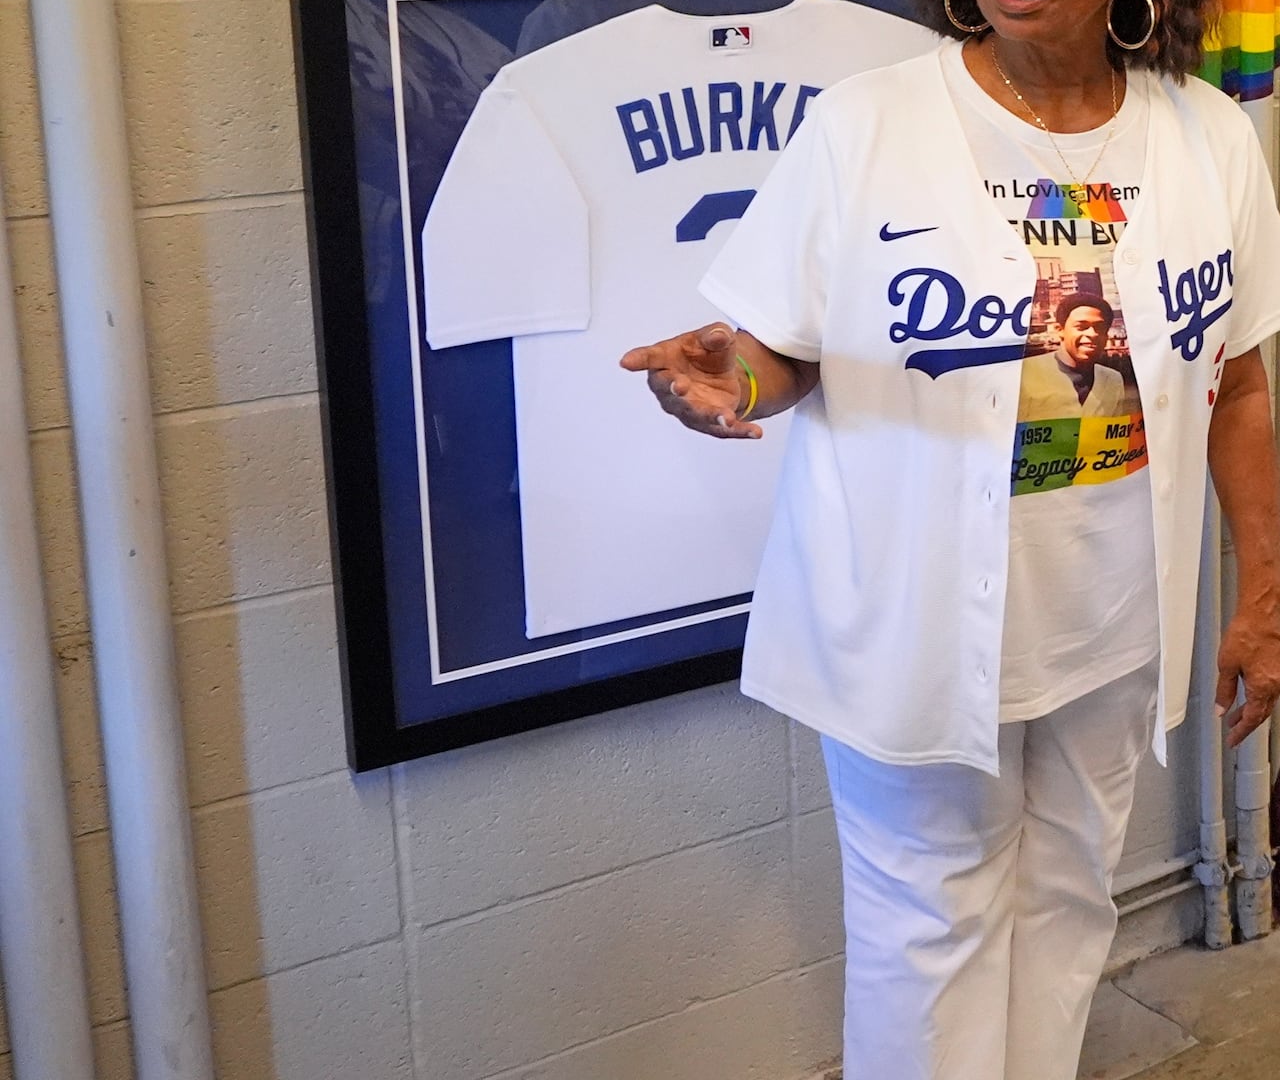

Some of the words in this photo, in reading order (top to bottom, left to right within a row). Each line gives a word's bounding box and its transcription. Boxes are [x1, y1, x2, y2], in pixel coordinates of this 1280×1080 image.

[1020, 426, 1053, 446] 1952
[1105, 423, 1134, 440] May
[1011, 456, 1087, 487] Legacy
